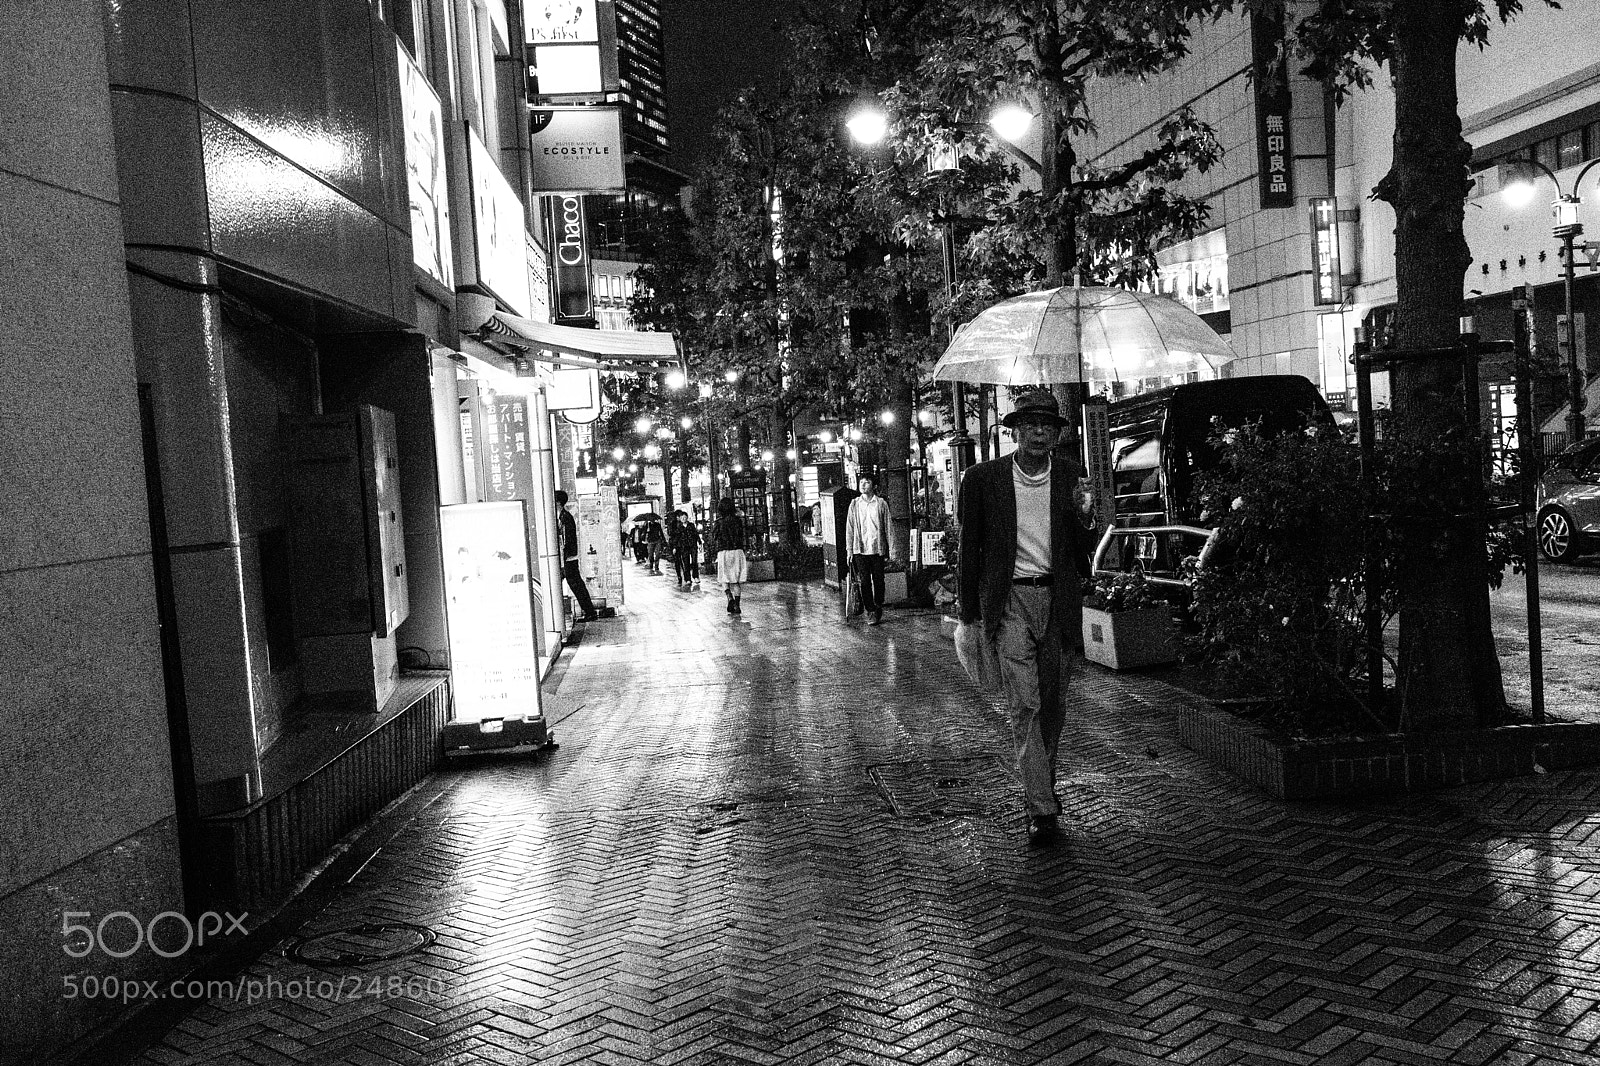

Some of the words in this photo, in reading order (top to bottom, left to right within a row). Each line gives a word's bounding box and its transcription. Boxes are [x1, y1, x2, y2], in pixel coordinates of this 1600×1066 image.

[534, 114, 545, 125] 1F
[543, 146, 610, 155] ECOSTYLE
[1266, 114, 1287, 193] 無印良品
[500, 404, 516, 500] アパート・マンション
